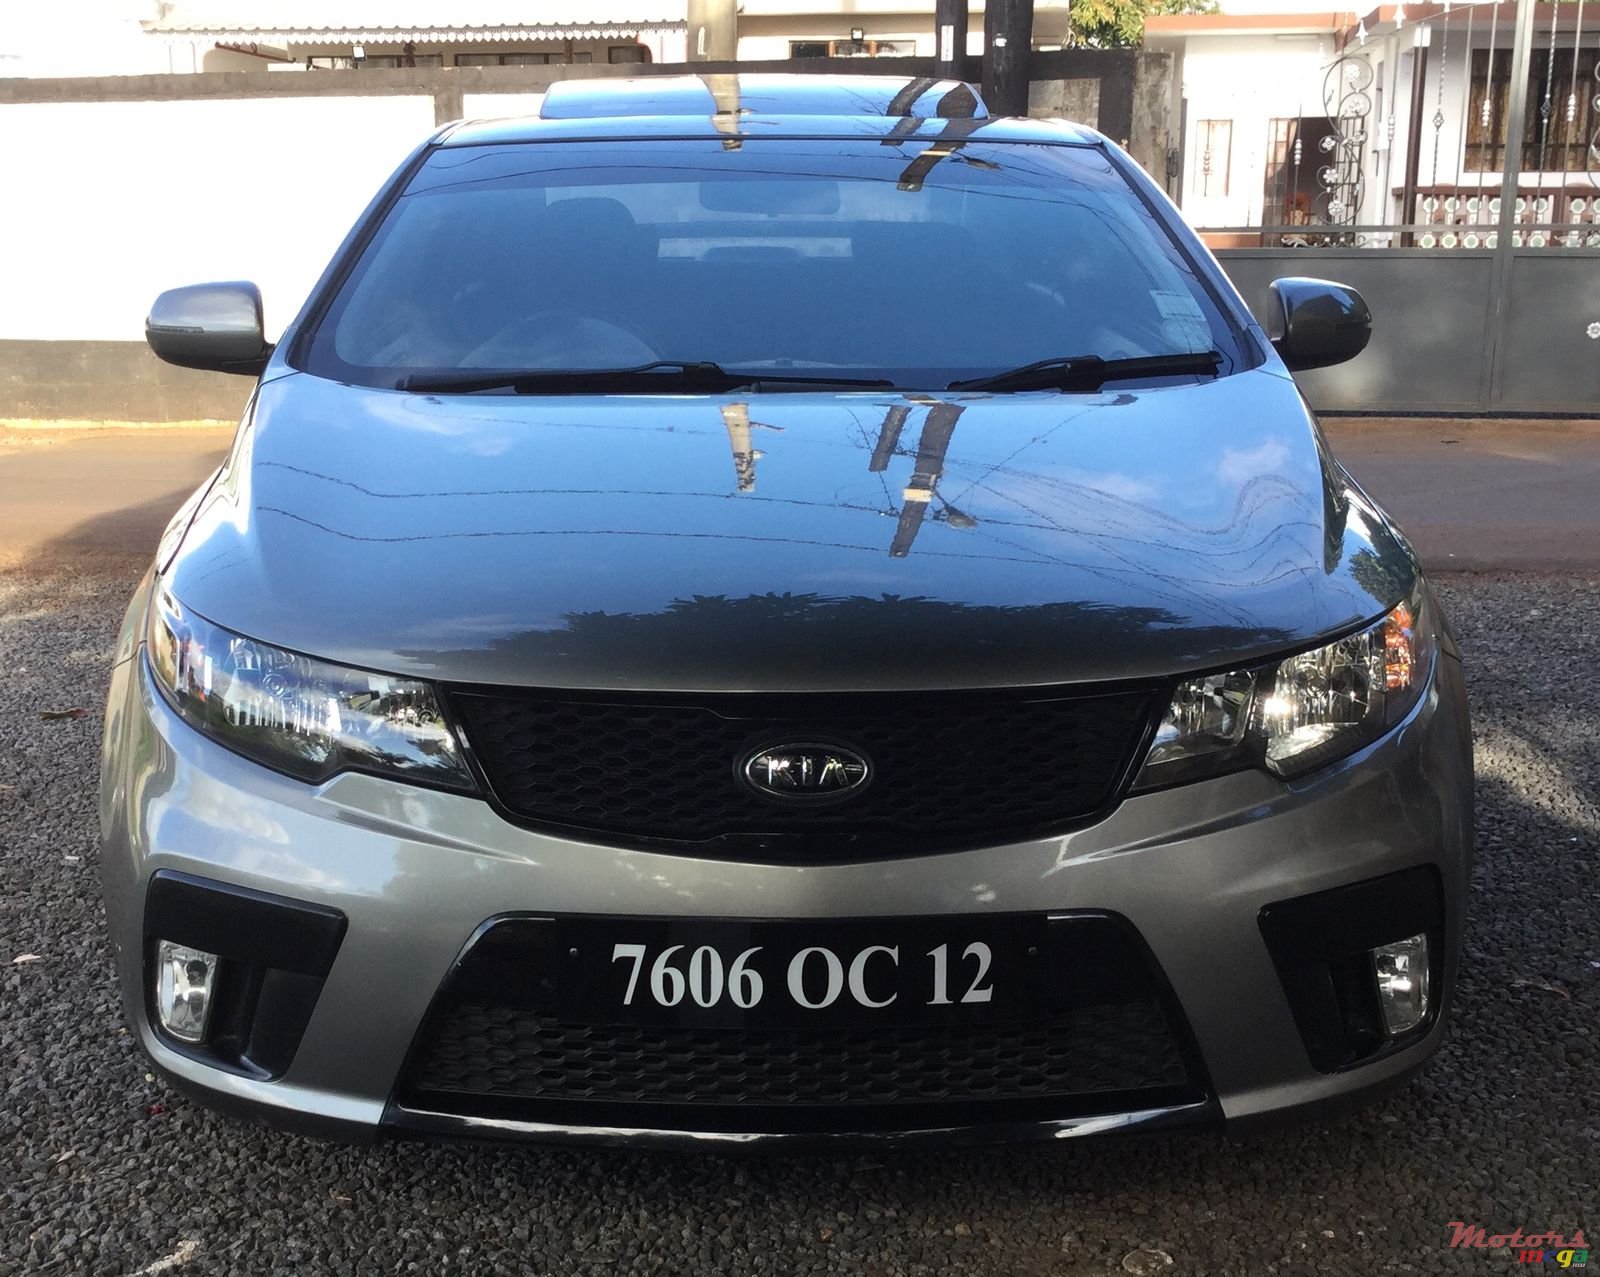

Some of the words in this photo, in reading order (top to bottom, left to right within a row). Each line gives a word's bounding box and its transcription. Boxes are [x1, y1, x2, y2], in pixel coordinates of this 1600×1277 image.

[766, 755, 849, 786] KIA
[611, 942, 764, 1009] 7606
[786, 944, 900, 1009] OC
[925, 941, 995, 1005] 12
